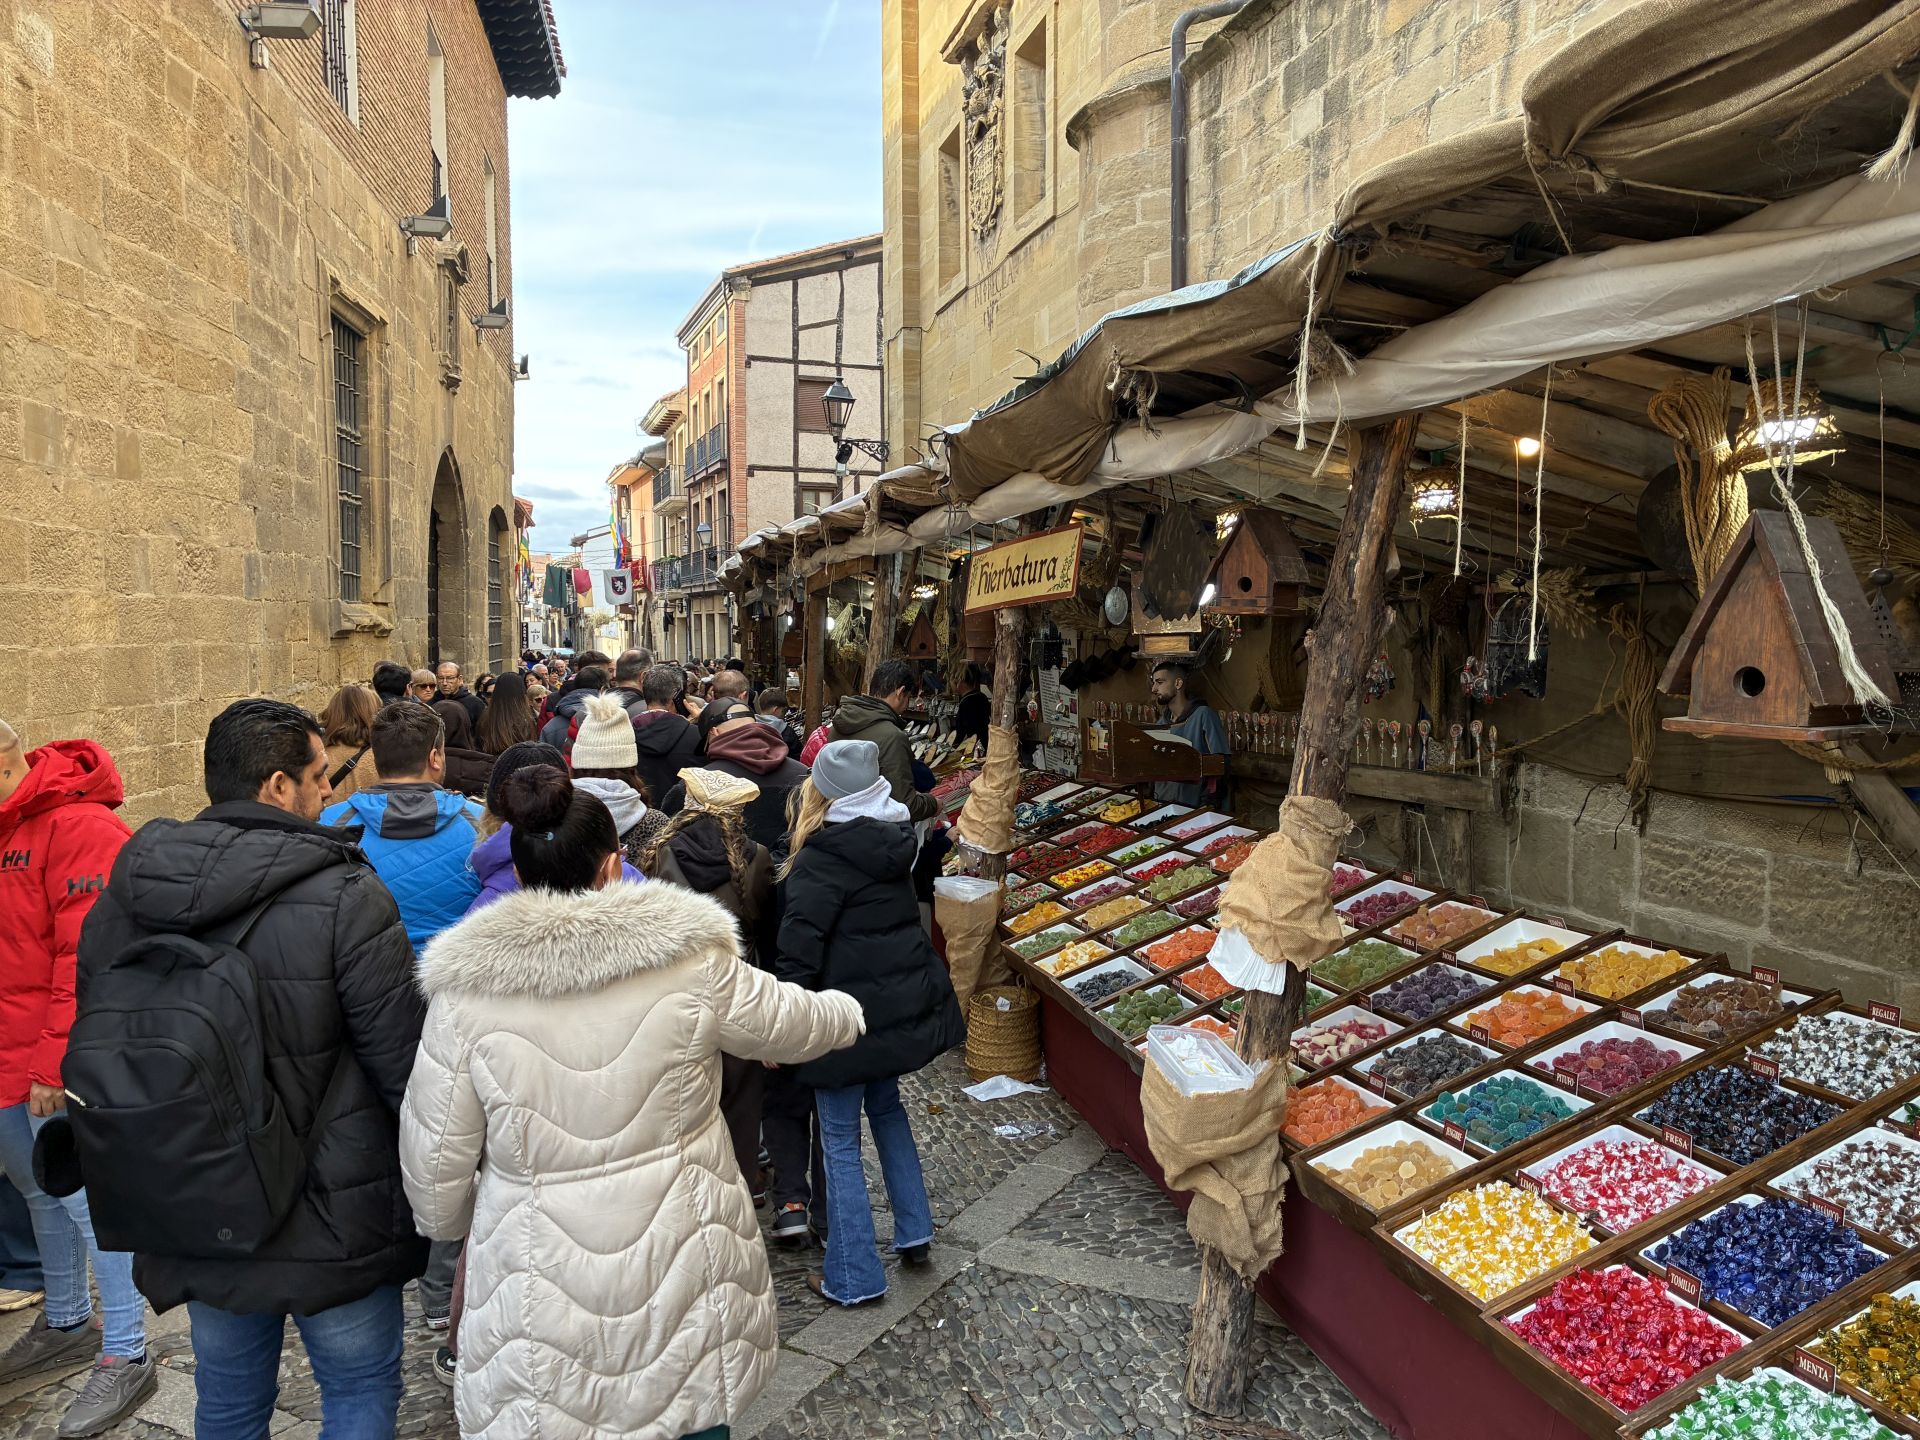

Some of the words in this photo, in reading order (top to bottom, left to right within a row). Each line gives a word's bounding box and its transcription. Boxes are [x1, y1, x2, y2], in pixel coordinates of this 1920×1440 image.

[1, 849, 31, 868] HH
[1871, 1007, 1897, 1022] REGALIZ
[1471, 1029, 1486, 1042] COLA
[1556, 1072, 1575, 1087] PITUFO
[1665, 1131, 1688, 1150] FRESA
[1670, 1271, 1696, 1296] TOMILLO
[1798, 1355, 1830, 1383] MENTA
